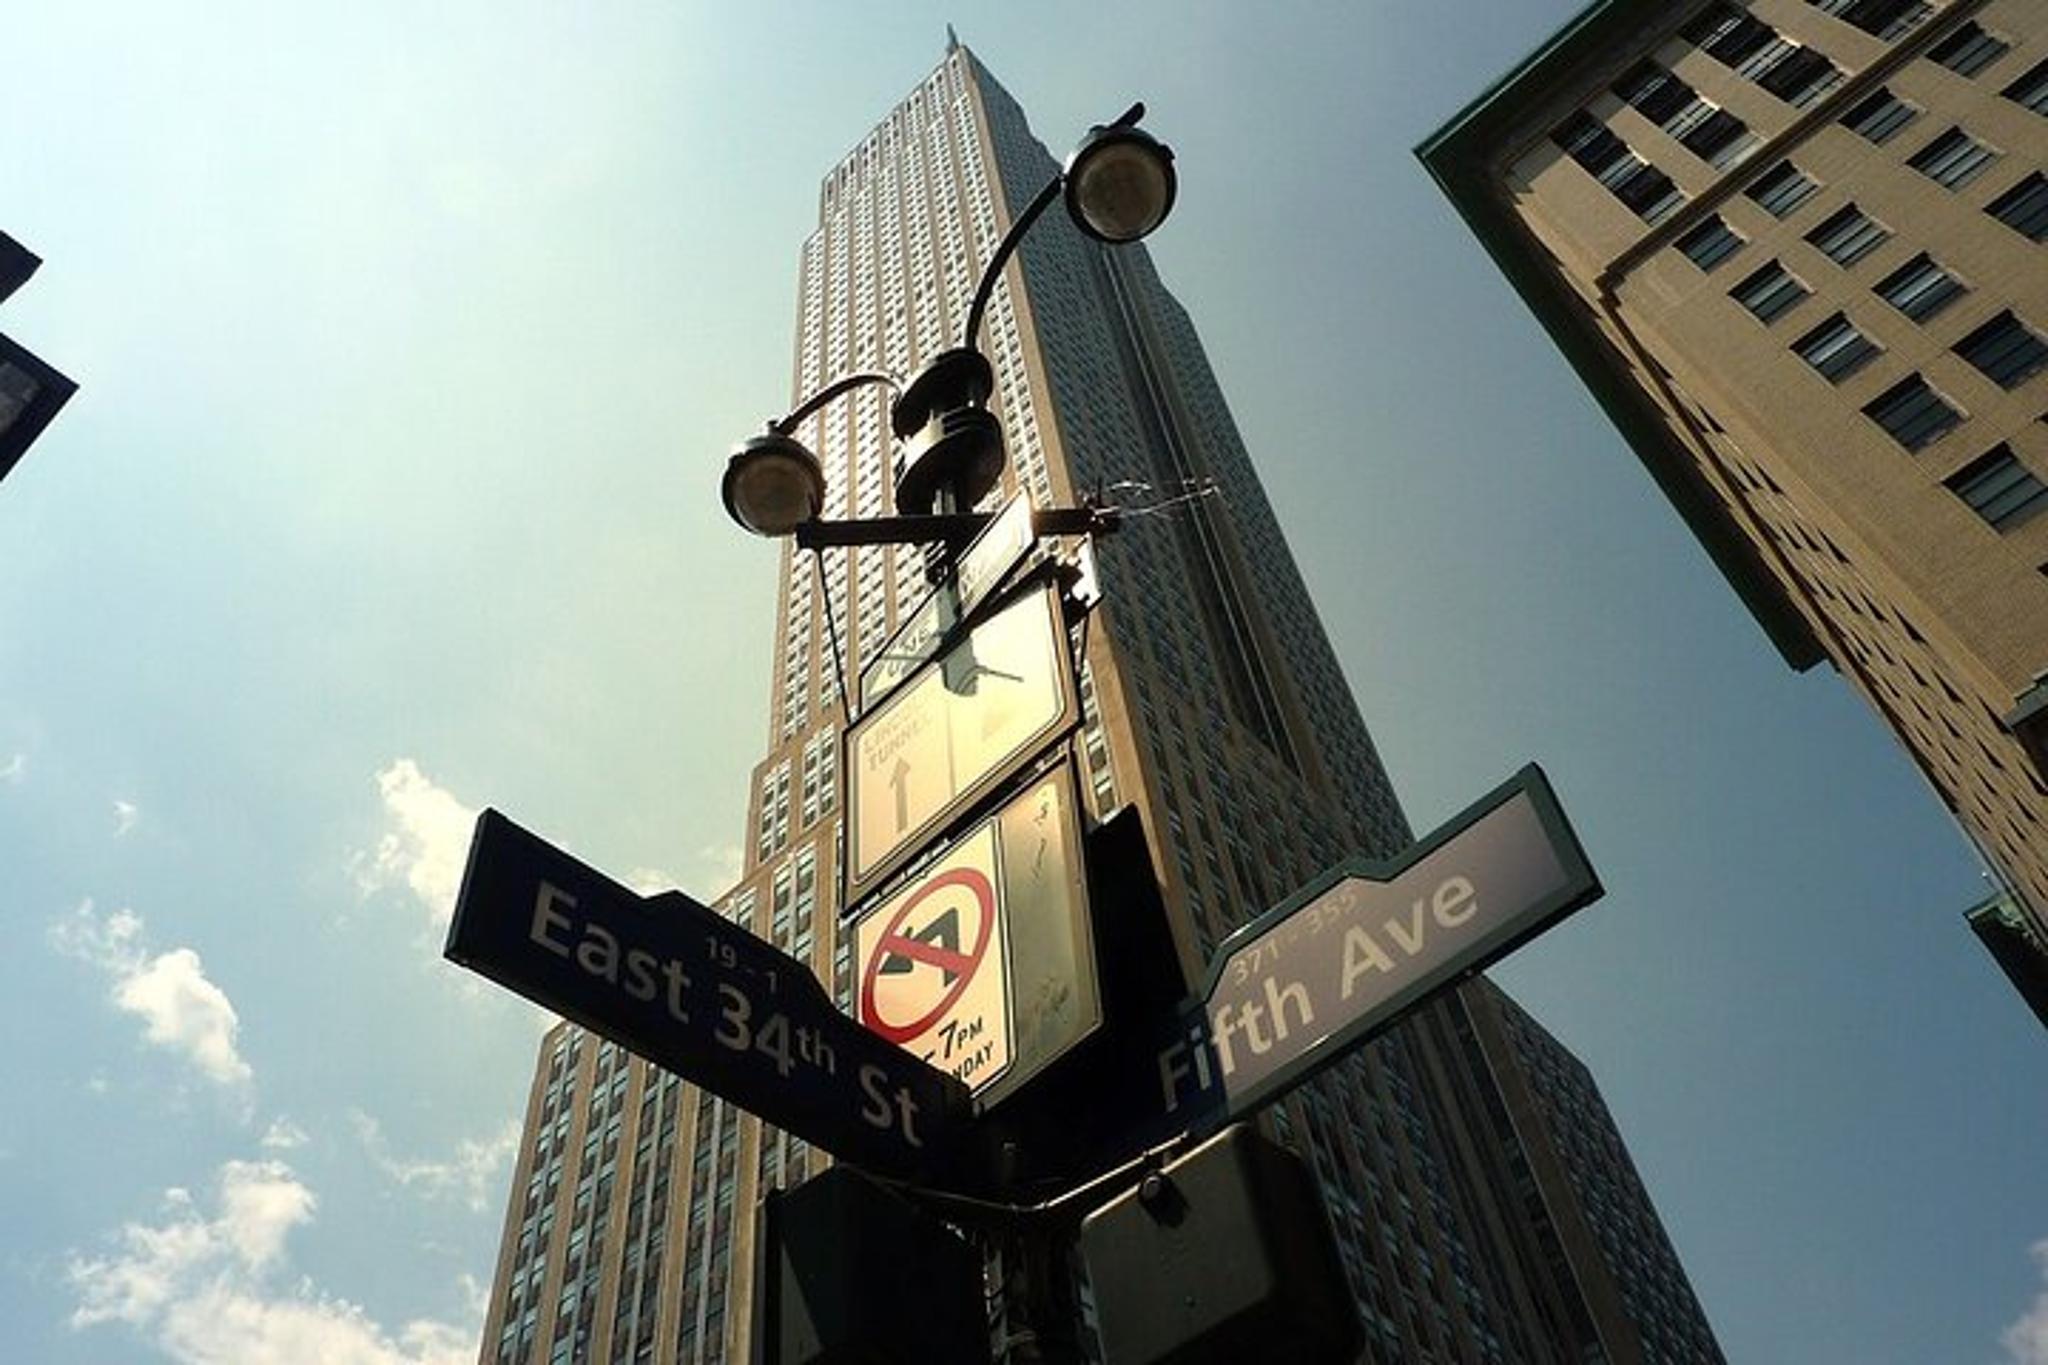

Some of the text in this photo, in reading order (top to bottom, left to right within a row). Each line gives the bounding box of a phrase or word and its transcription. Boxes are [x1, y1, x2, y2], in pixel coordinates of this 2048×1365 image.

[529, 880, 924, 1148] East 34th St
[705, 936, 737, 968] 19
[765, 971, 778, 994] 1
[1157, 875, 1478, 1112] Fifth Ave
[1231, 937, 1279, 985] 371
